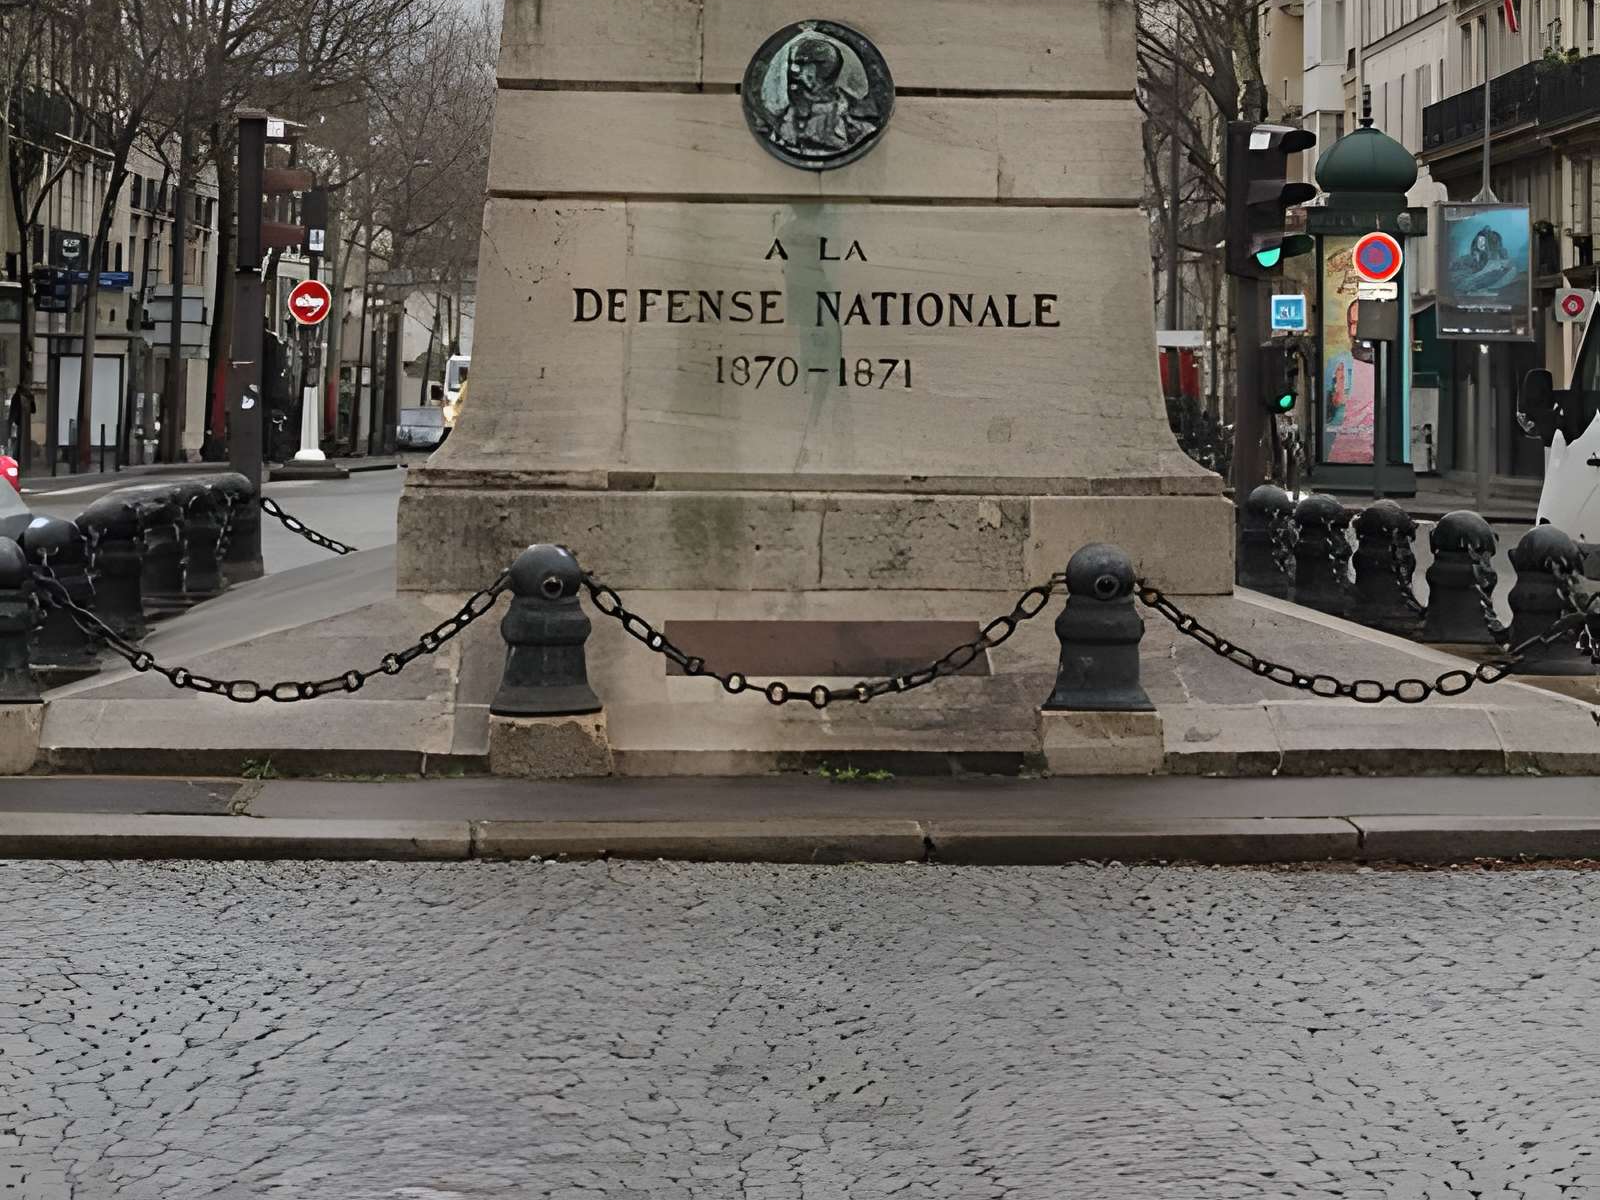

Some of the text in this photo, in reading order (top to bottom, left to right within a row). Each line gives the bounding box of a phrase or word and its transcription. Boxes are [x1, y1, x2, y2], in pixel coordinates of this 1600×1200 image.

[764, 236, 868, 262] A LA
[572, 287, 1061, 328] DEFENSE NATIONALE
